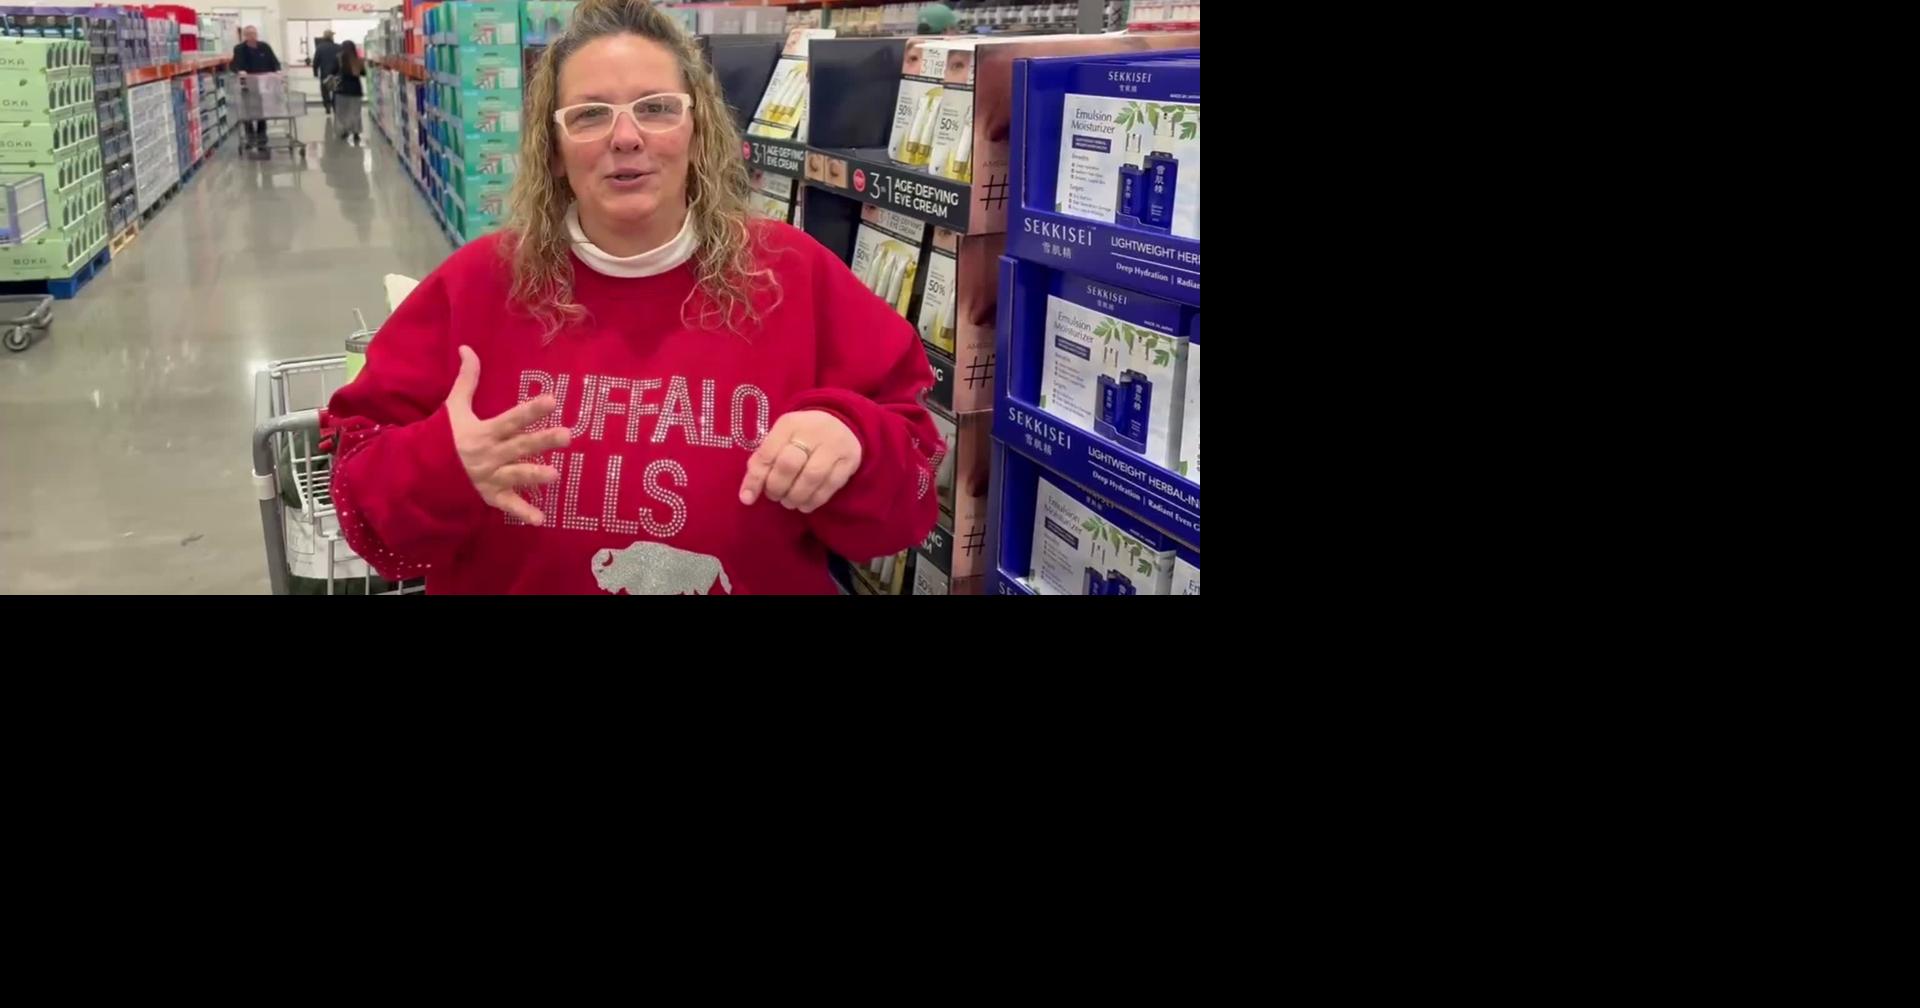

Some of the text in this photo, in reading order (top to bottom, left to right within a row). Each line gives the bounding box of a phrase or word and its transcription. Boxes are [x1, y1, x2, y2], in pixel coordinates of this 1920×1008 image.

[1108, 70, 1152, 83] SEKKISEI
[939, 117, 960, 132] 50%
[1075, 108, 1112, 122] Emulsion
[1071, 121, 1115, 134] Moisturizer
[894, 178, 959, 206] AGE-DEFYING
[895, 192, 948, 219] EYE CREAM
[1024, 217, 1092, 246] SEKKISEI
[1111, 236, 1176, 260] LIGHTWEIGHT
[1116, 262, 1133, 276] Deep
[1135, 267, 1168, 282] Hydration
[928, 279, 946, 296] 50%
[1087, 285, 1127, 305] SEKKISEI
[1058, 312, 1091, 331] Emulsion
[518, 369, 770, 452] BUFFALO
[1008, 407, 1071, 450] SEKKISEI
[1088, 446, 1147, 482] LIGHTWEIGHT
[1092, 471, 1108, 485] Deep
[1109, 480, 1141, 500] Hydration
[1148, 499, 1173, 518] Radiant
[1175, 513, 1192, 528] Even
